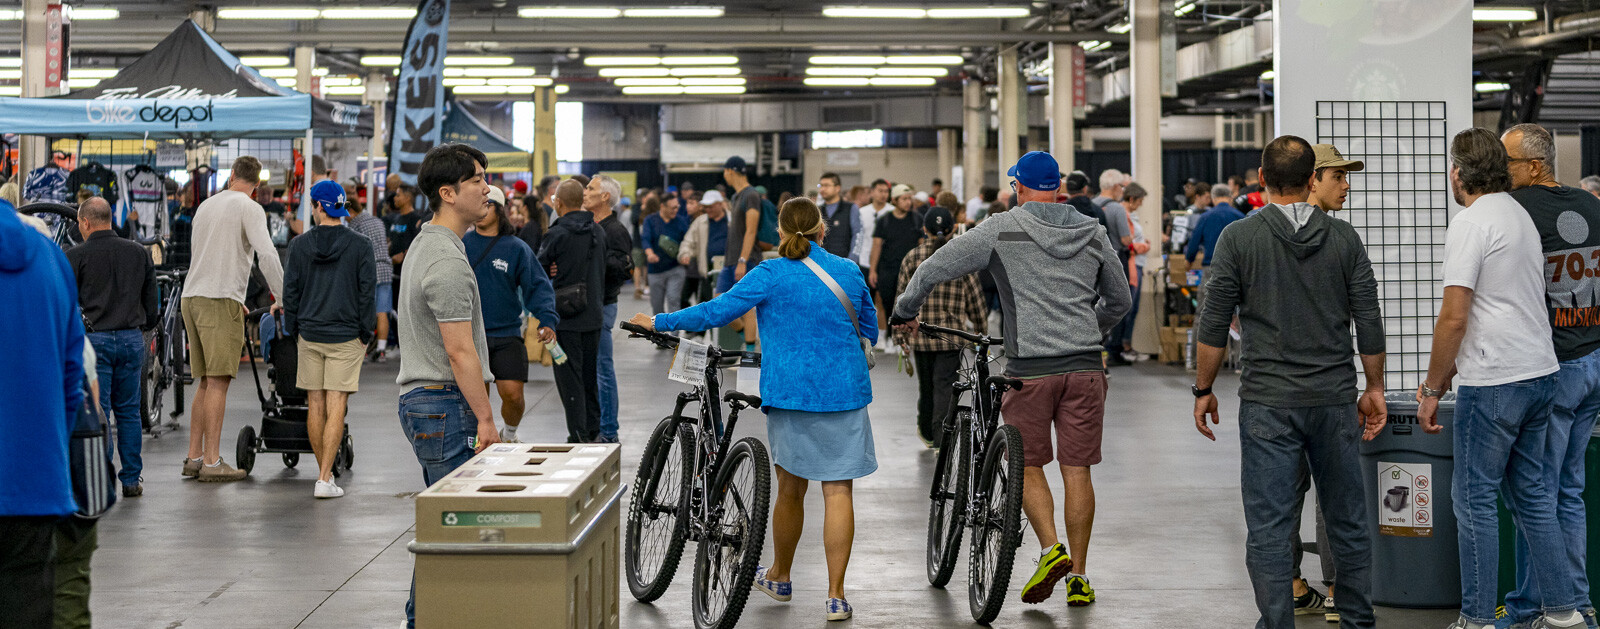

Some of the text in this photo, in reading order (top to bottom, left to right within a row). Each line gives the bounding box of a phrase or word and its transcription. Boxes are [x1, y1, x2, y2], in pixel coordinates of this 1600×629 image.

[86, 100, 214, 129] bike depot
[399, 32, 440, 208] IKES
[936, 216, 942, 224] 3
[1387, 414, 1419, 425] RUT
[476, 514, 520, 524] COMPOST
